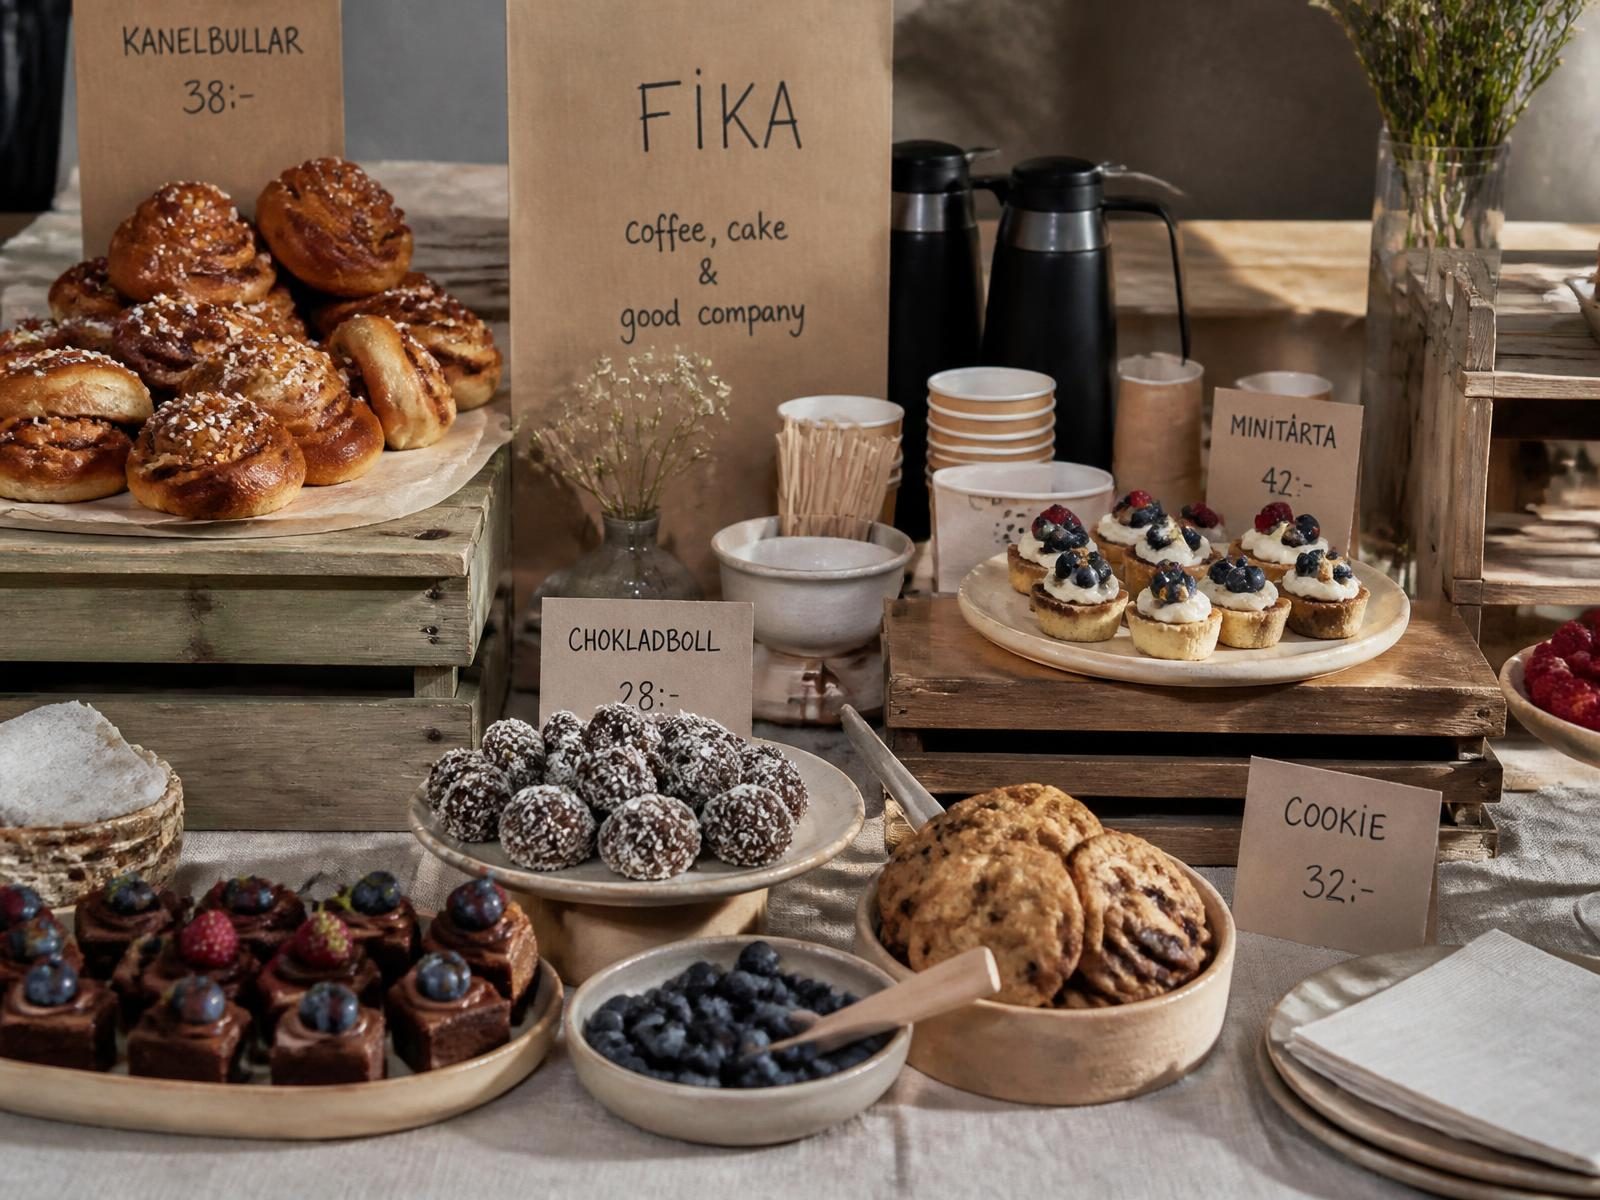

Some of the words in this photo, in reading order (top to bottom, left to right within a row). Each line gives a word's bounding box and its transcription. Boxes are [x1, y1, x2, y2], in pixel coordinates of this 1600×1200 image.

[122, 25, 304, 57] KANELBULLAR
[182, 79, 255, 115] 38:-
[625, 213, 718, 253] coffee,
[727, 211, 790, 243] cake
[698, 257, 719, 286] &
[620, 298, 681, 345] good
[697, 303, 806, 338] company
[1261, 466, 1313, 498] 42:-
[568, 626, 721, 653] CHOKLADBOLL
